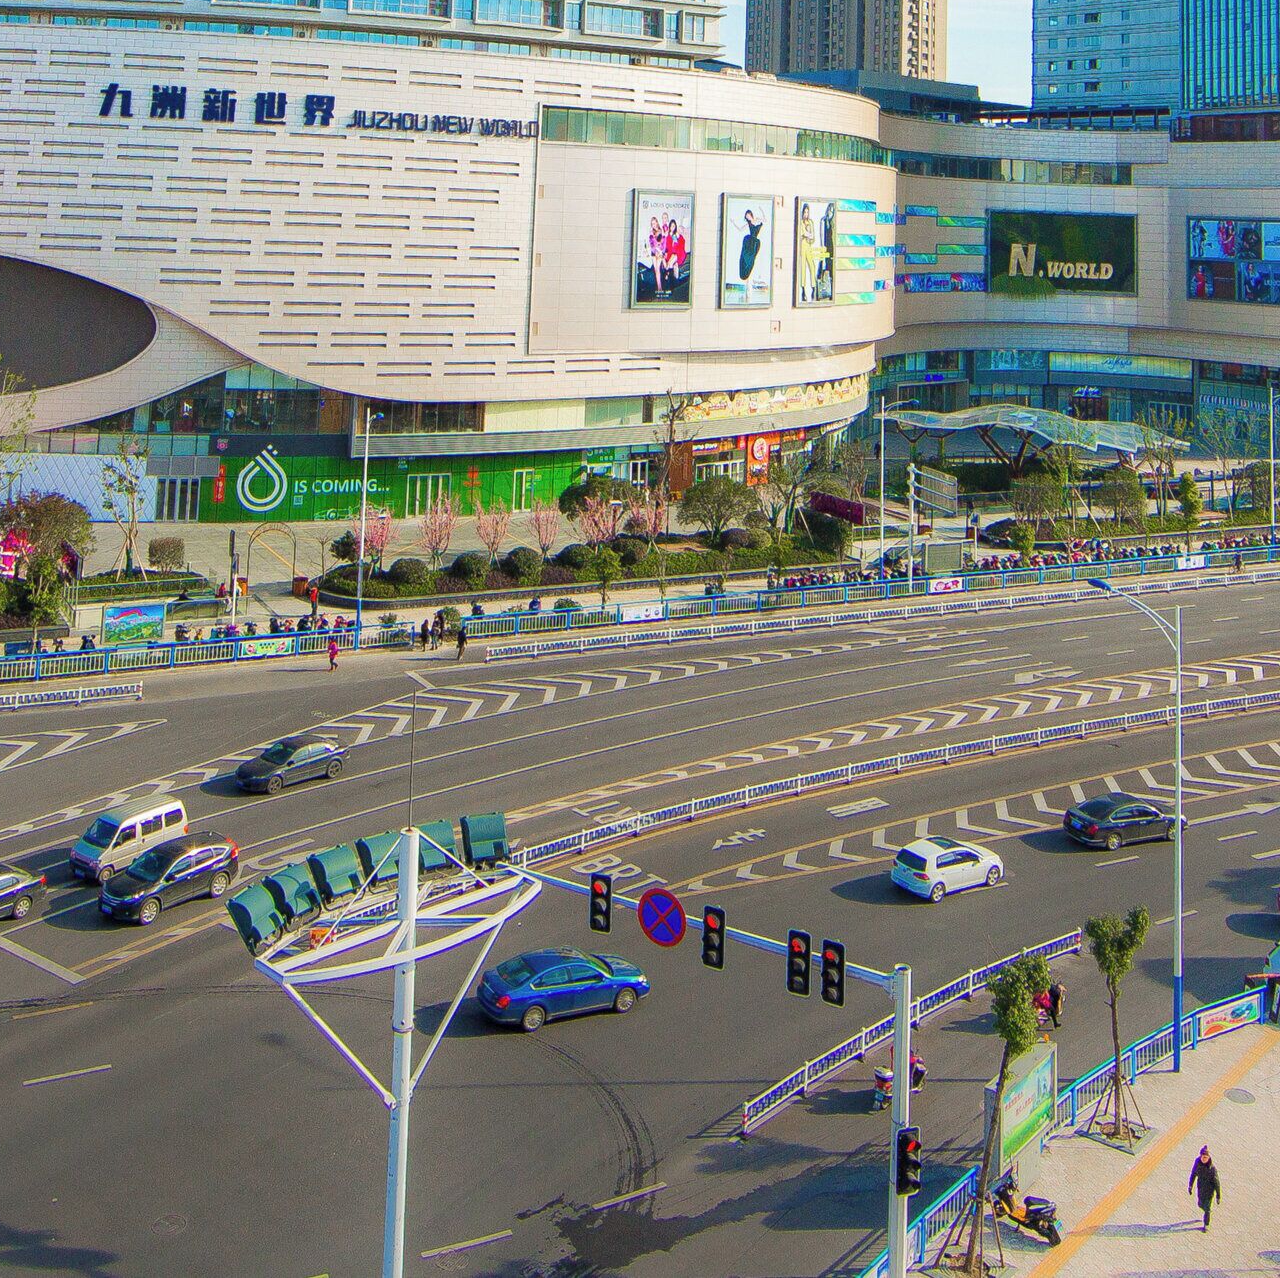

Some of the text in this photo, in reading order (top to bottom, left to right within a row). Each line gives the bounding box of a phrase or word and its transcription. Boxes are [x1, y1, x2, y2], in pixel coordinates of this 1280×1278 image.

[100, 83, 336, 127] 九洲新世界
[346, 109, 538, 139] JIUZHOU NEW WORLD
[294, 480, 307, 494] IS
[571, 854, 669, 895] BRT
